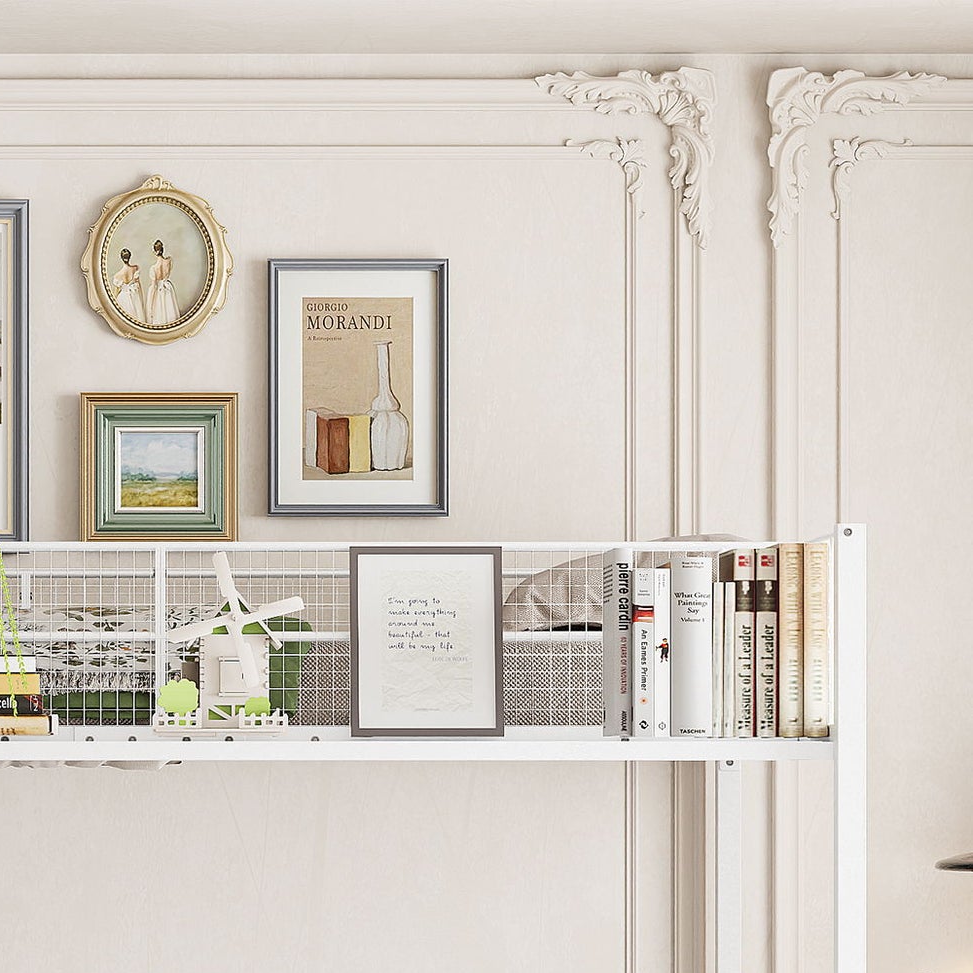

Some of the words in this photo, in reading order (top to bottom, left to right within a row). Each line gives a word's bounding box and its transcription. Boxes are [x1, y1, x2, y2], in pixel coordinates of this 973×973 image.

[307, 303, 348, 311] GIORGIO
[307, 315, 391, 330] MORANDI
[616, 563, 632, 594] pierre
[408, 599, 428, 607] going
[414, 608, 456, 618] everything
[619, 597, 632, 630] cardin
[388, 631, 423, 640] beautiful
[641, 629, 648, 639] An
[420, 644, 435, 652] my
[738, 625, 751, 660] Leader
[761, 625, 774, 660] Leader
[738, 673, 751, 685] of
[761, 673, 774, 685] of
